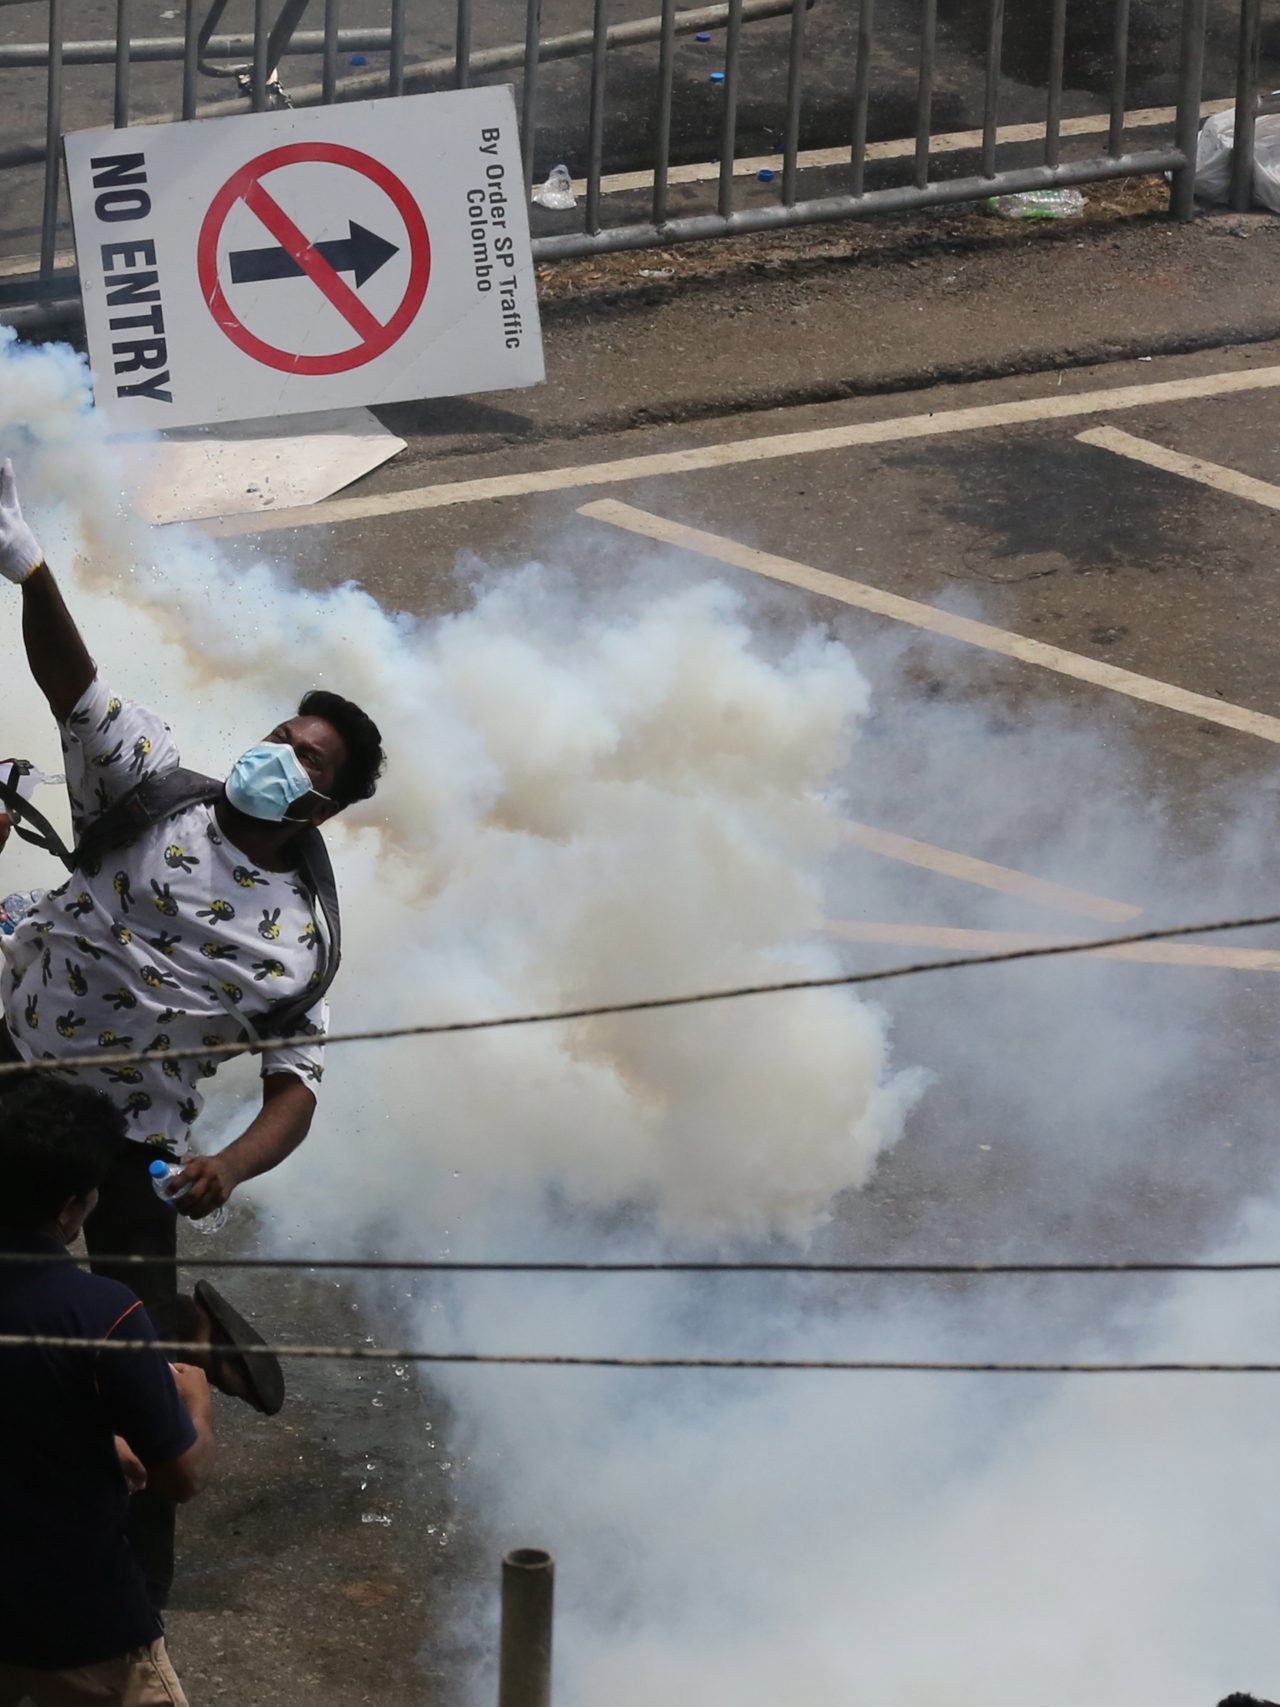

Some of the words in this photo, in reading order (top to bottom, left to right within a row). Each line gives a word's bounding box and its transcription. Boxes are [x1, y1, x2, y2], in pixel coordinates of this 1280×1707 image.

[478, 127, 500, 155] By
[89, 152, 152, 223] NO
[485, 164, 508, 229] Order
[466, 189, 494, 292] Colombo
[494, 236, 515, 268] SP
[100, 238, 173, 403] ENTRY
[499, 274, 522, 349] Traffic
